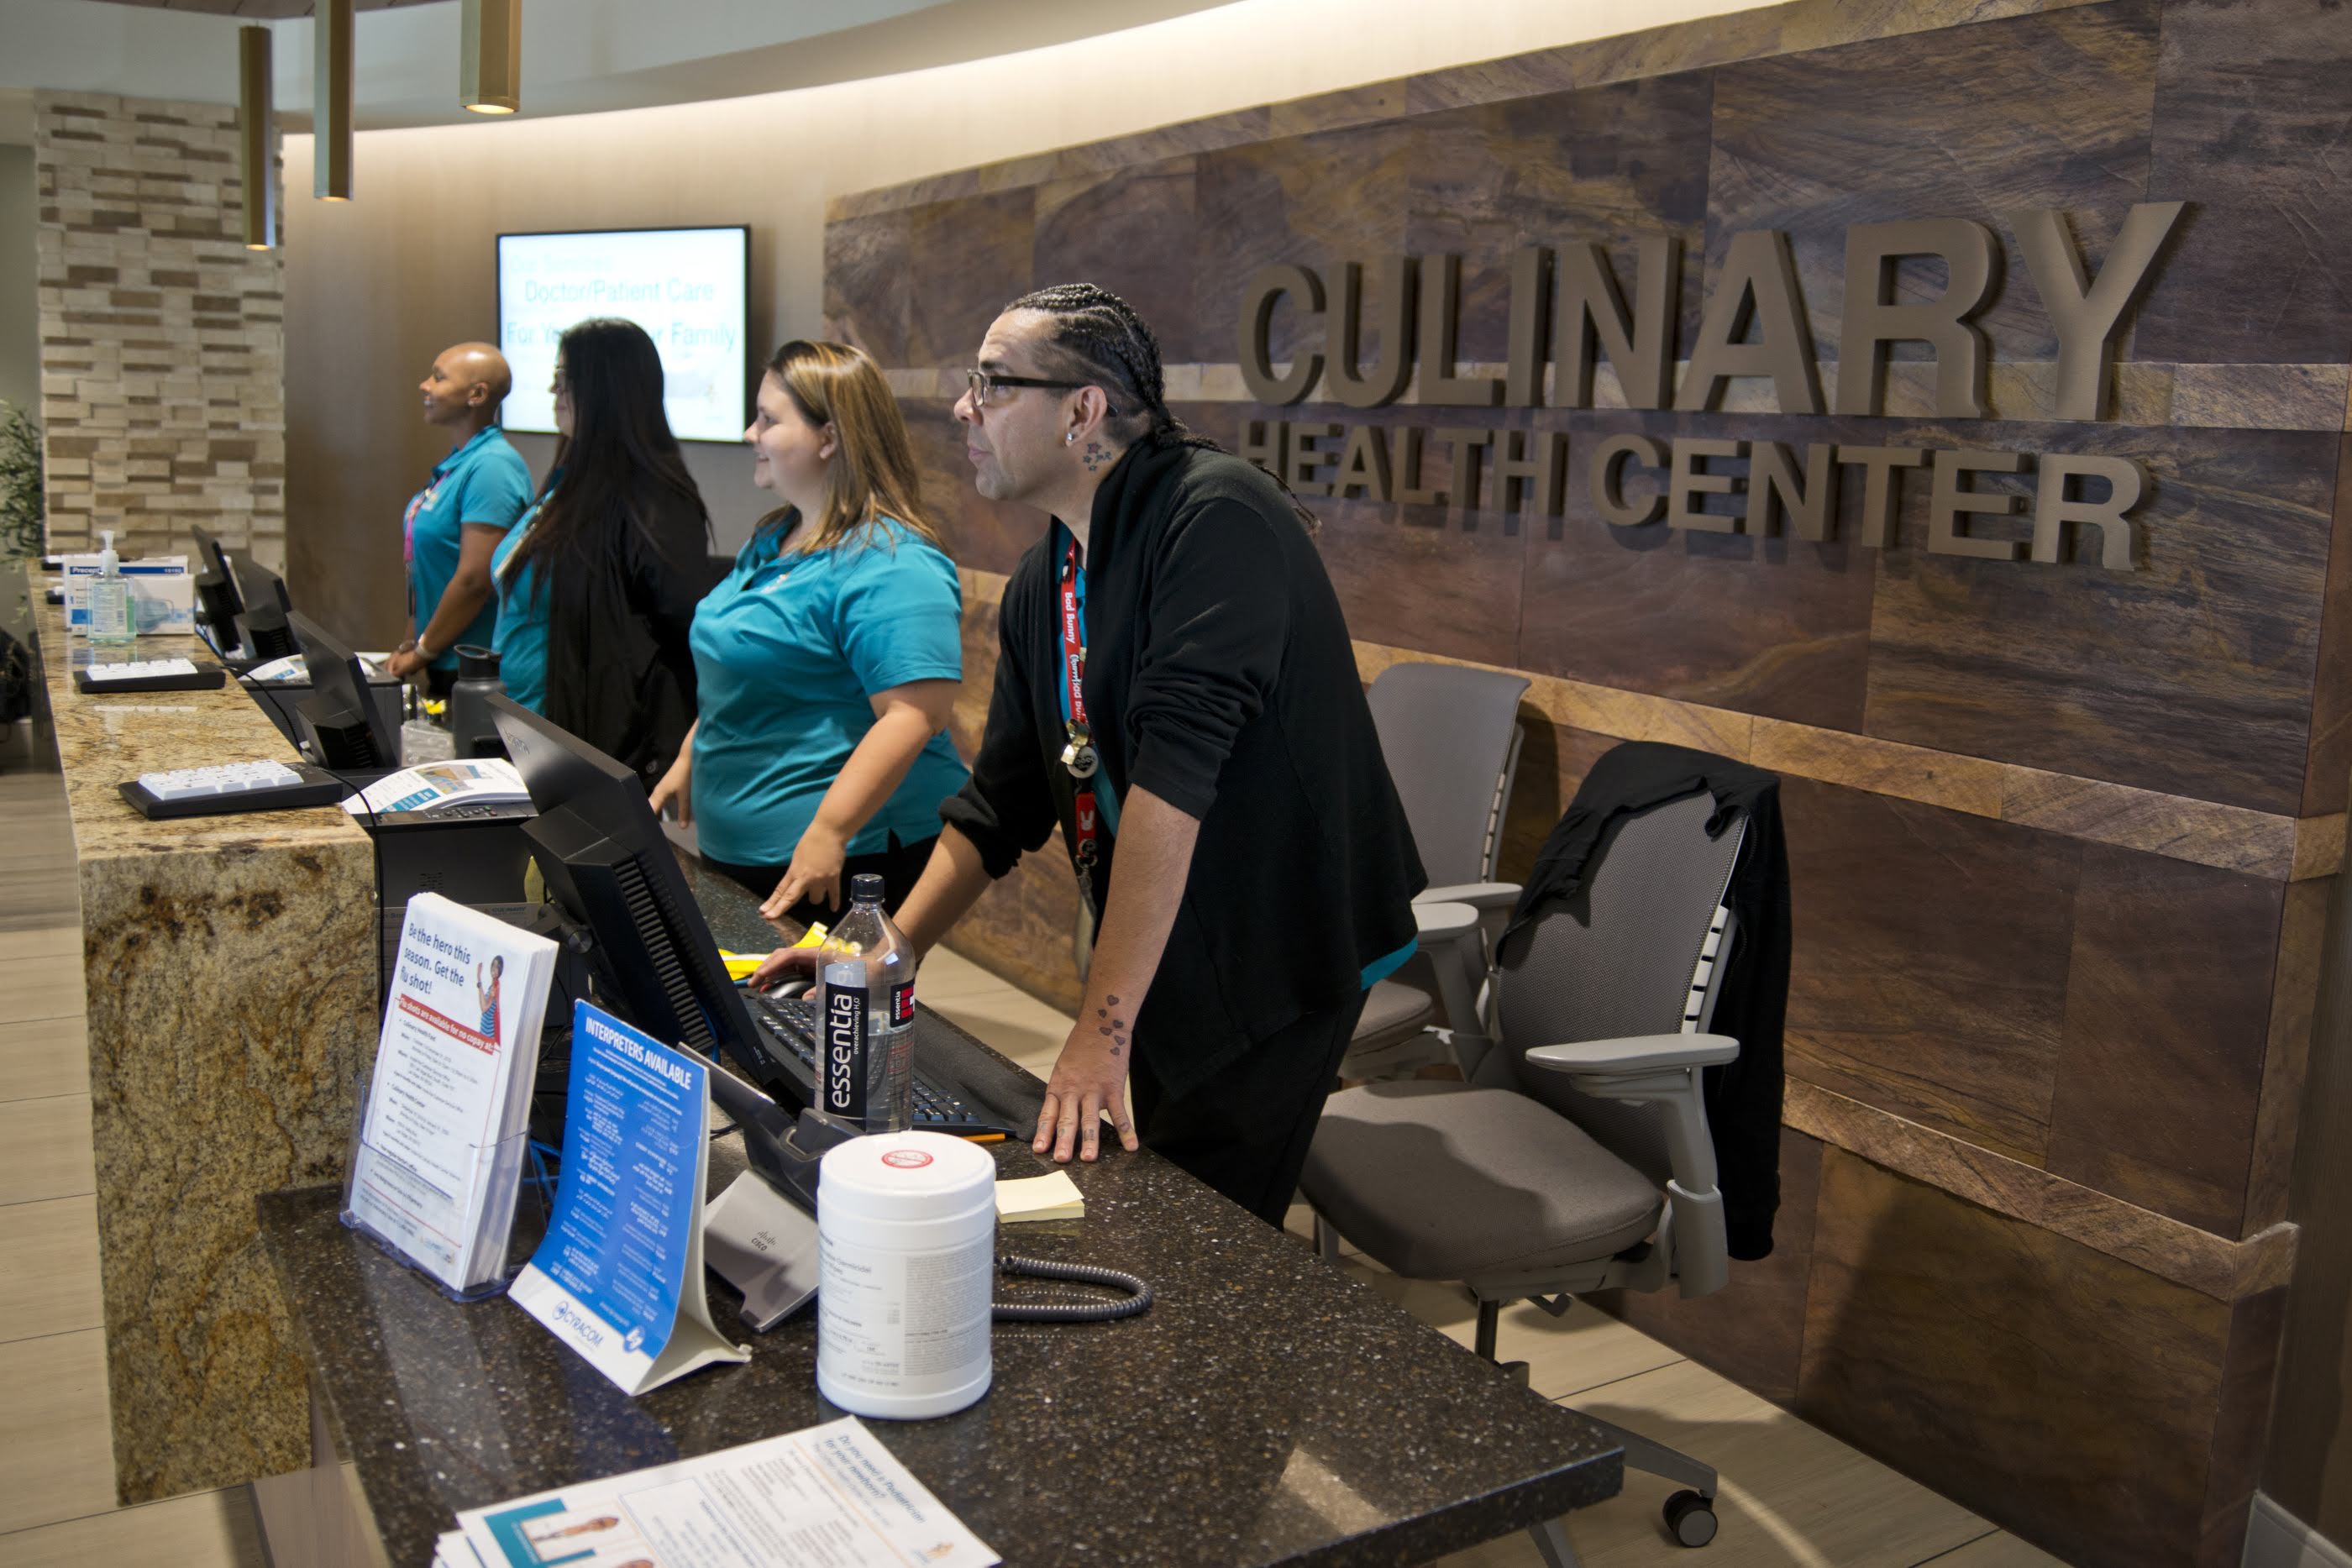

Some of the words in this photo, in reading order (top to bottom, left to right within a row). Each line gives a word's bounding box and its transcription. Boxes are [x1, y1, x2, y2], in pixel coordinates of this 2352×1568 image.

[524, 279, 661, 303] Doctor/Patient
[666, 276, 715, 302] Care
[1238, 202, 2186, 420] CULINARY
[507, 322, 536, 343] For
[670, 318, 736, 353] Family
[1239, 421, 1561, 518] HEALTH
[1589, 433, 2145, 571] CENTER
[1064, 591, 1075, 611] Bad
[1065, 613, 1076, 644] Bunny
[408, 922, 417, 939] Be
[417, 928, 432, 947] the
[433, 933, 454, 956] hero
[454, 945, 471, 965] this
[400, 965, 409, 983] flu
[408, 973, 433, 995] shot!
[404, 947, 432, 971] season.
[434, 960, 449, 979] Get
[449, 967, 465, 987] the
[407, 1002, 421, 1015] shots
[420, 1009, 429, 1020] are
[428, 1013, 450, 1031] available
[449, 1024, 458, 1036] for
[458, 1030, 467, 1040] no
[466, 1034, 485, 1049] copay
[585, 1015, 645, 1062] INTERPRETERS
[643, 1049, 693, 1091] AVAILABLE
[829, 994, 853, 1108] essentia
[564, 1310, 605, 1349] CYRACOM
[824, 1439, 836, 1452] for
[832, 1449, 852, 1465] your
[848, 1466, 888, 1499] newborn?
[838, 1435, 851, 1445] Do
[845, 1446, 864, 1460] you
[862, 1459, 881, 1476] need
[885, 1481, 927, 1524] Pediatrician
